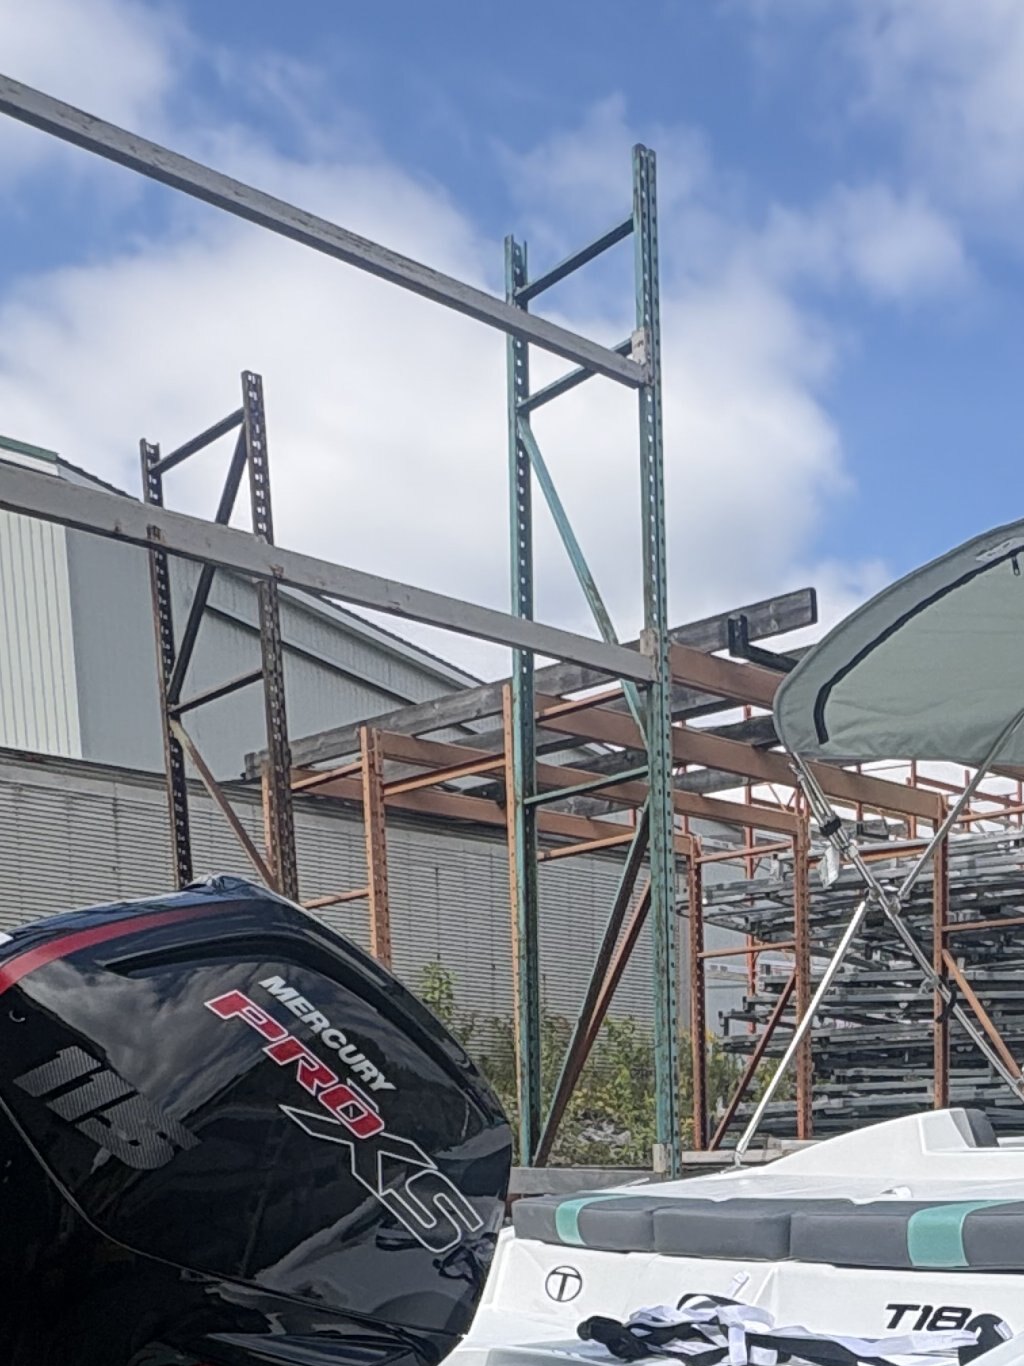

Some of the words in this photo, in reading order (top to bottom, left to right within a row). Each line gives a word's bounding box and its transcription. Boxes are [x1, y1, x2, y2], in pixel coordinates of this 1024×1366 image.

[204, 989, 385, 1140] PRO
[259, 975, 396, 1092] MERCURY
[279, 1104, 484, 1253] XS
[885, 1303, 973, 1332] T18
